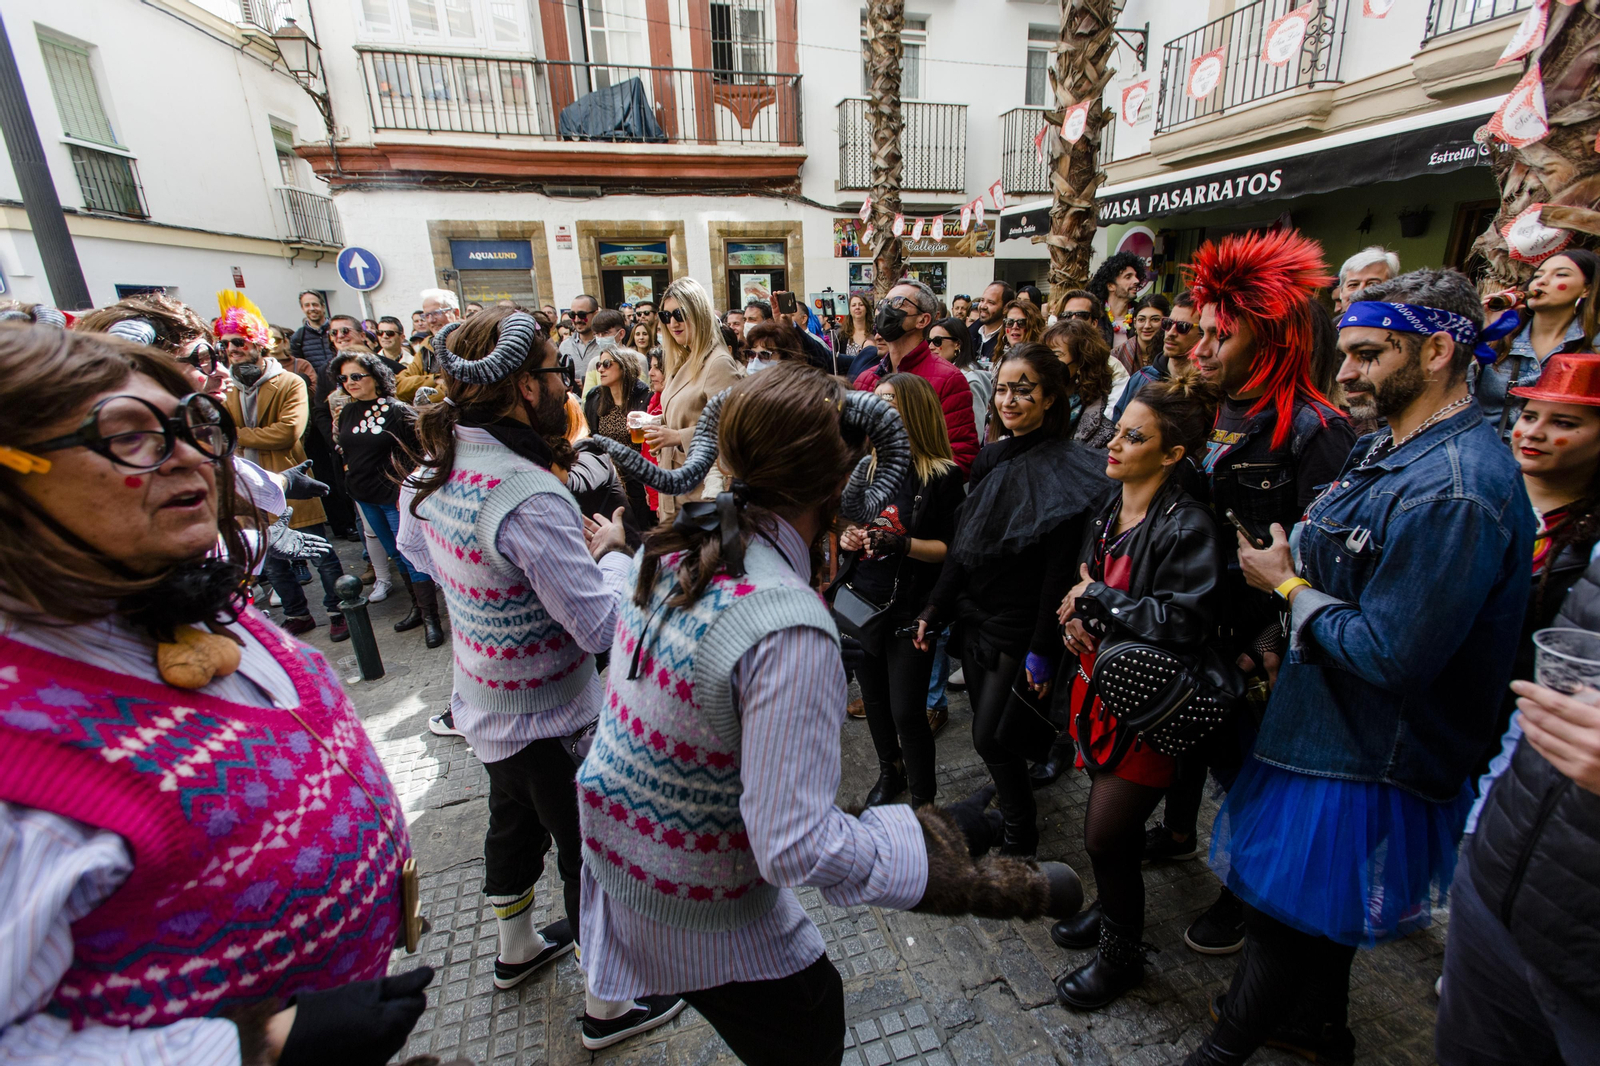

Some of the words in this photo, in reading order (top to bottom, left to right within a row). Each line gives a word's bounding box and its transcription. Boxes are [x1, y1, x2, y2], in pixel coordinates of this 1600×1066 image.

[1427, 146, 1476, 166] Estrella
[1147, 169, 1283, 213] PASARRATOS
[469, 252, 518, 261] AQUALUND
[903, 240, 949, 256] Callejón
